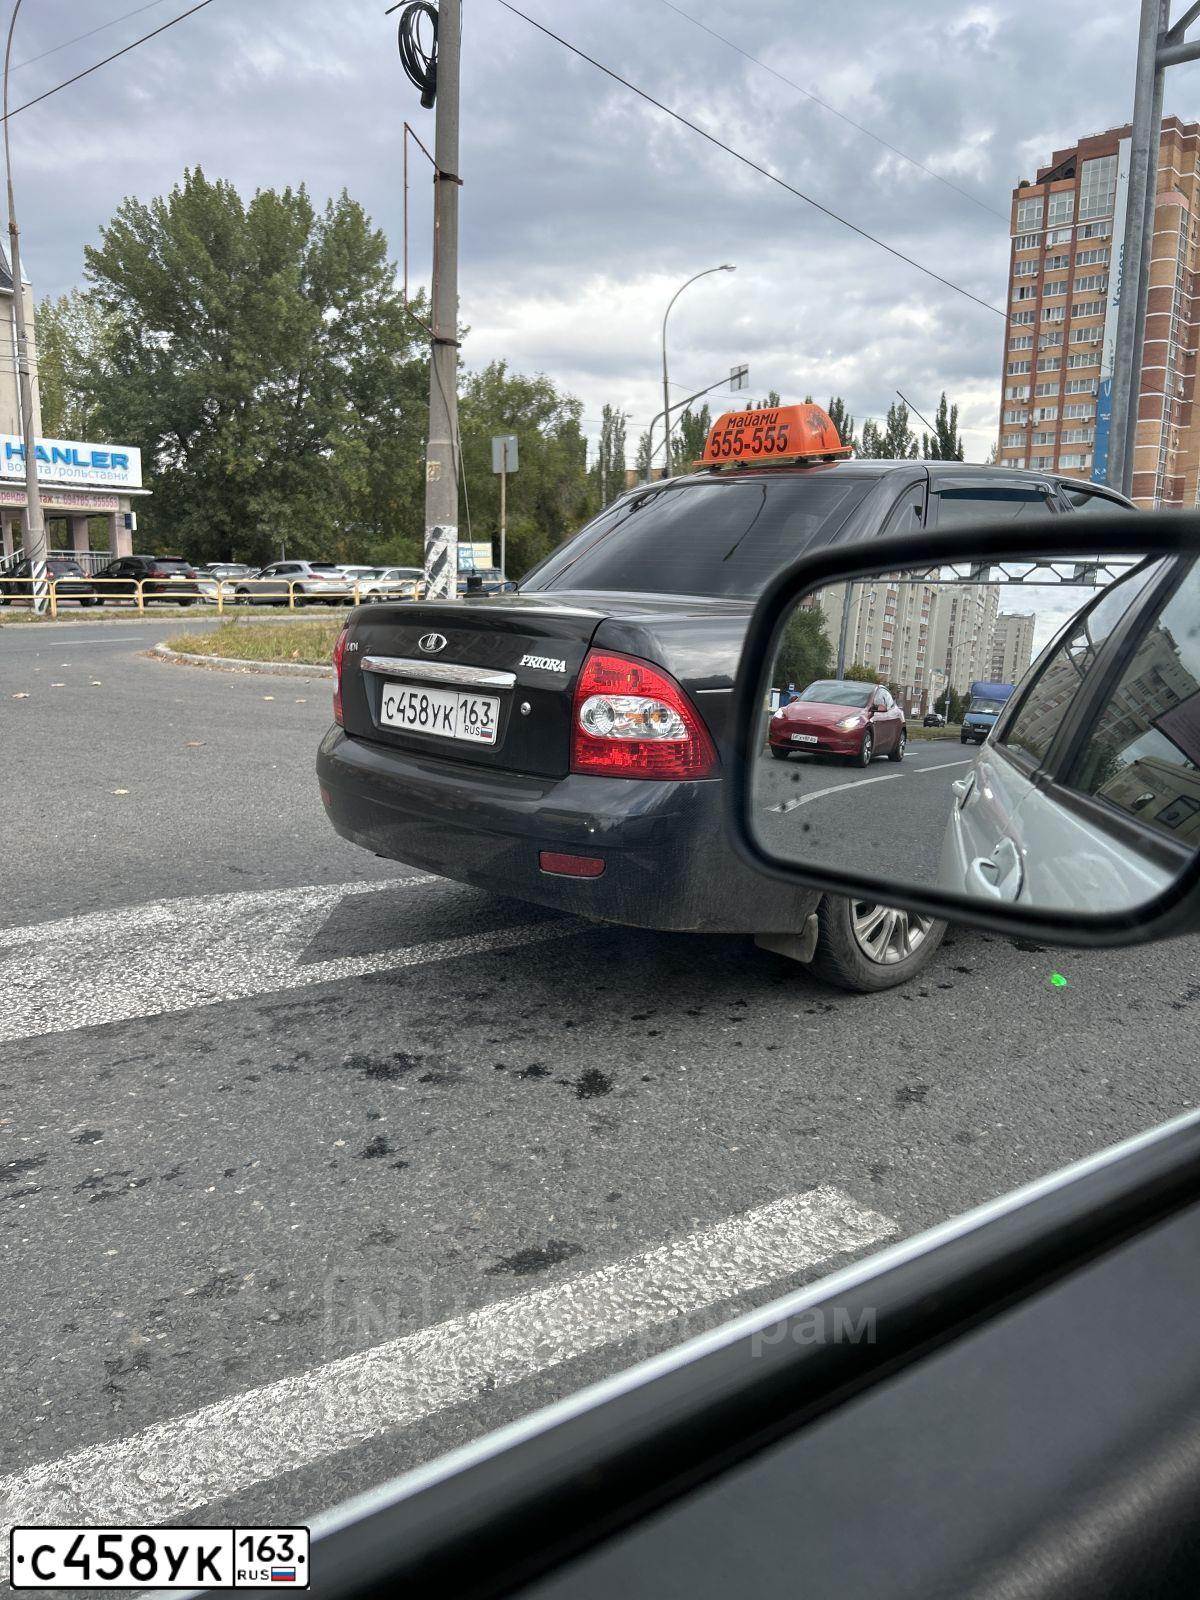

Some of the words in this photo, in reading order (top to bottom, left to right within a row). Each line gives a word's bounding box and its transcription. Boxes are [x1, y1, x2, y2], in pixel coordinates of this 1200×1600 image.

[711, 425, 789, 457] 555-555
[519, 654, 567, 673] PRIORA
[459, 699, 491, 726] 163
[464, 724, 481, 736] RUS
